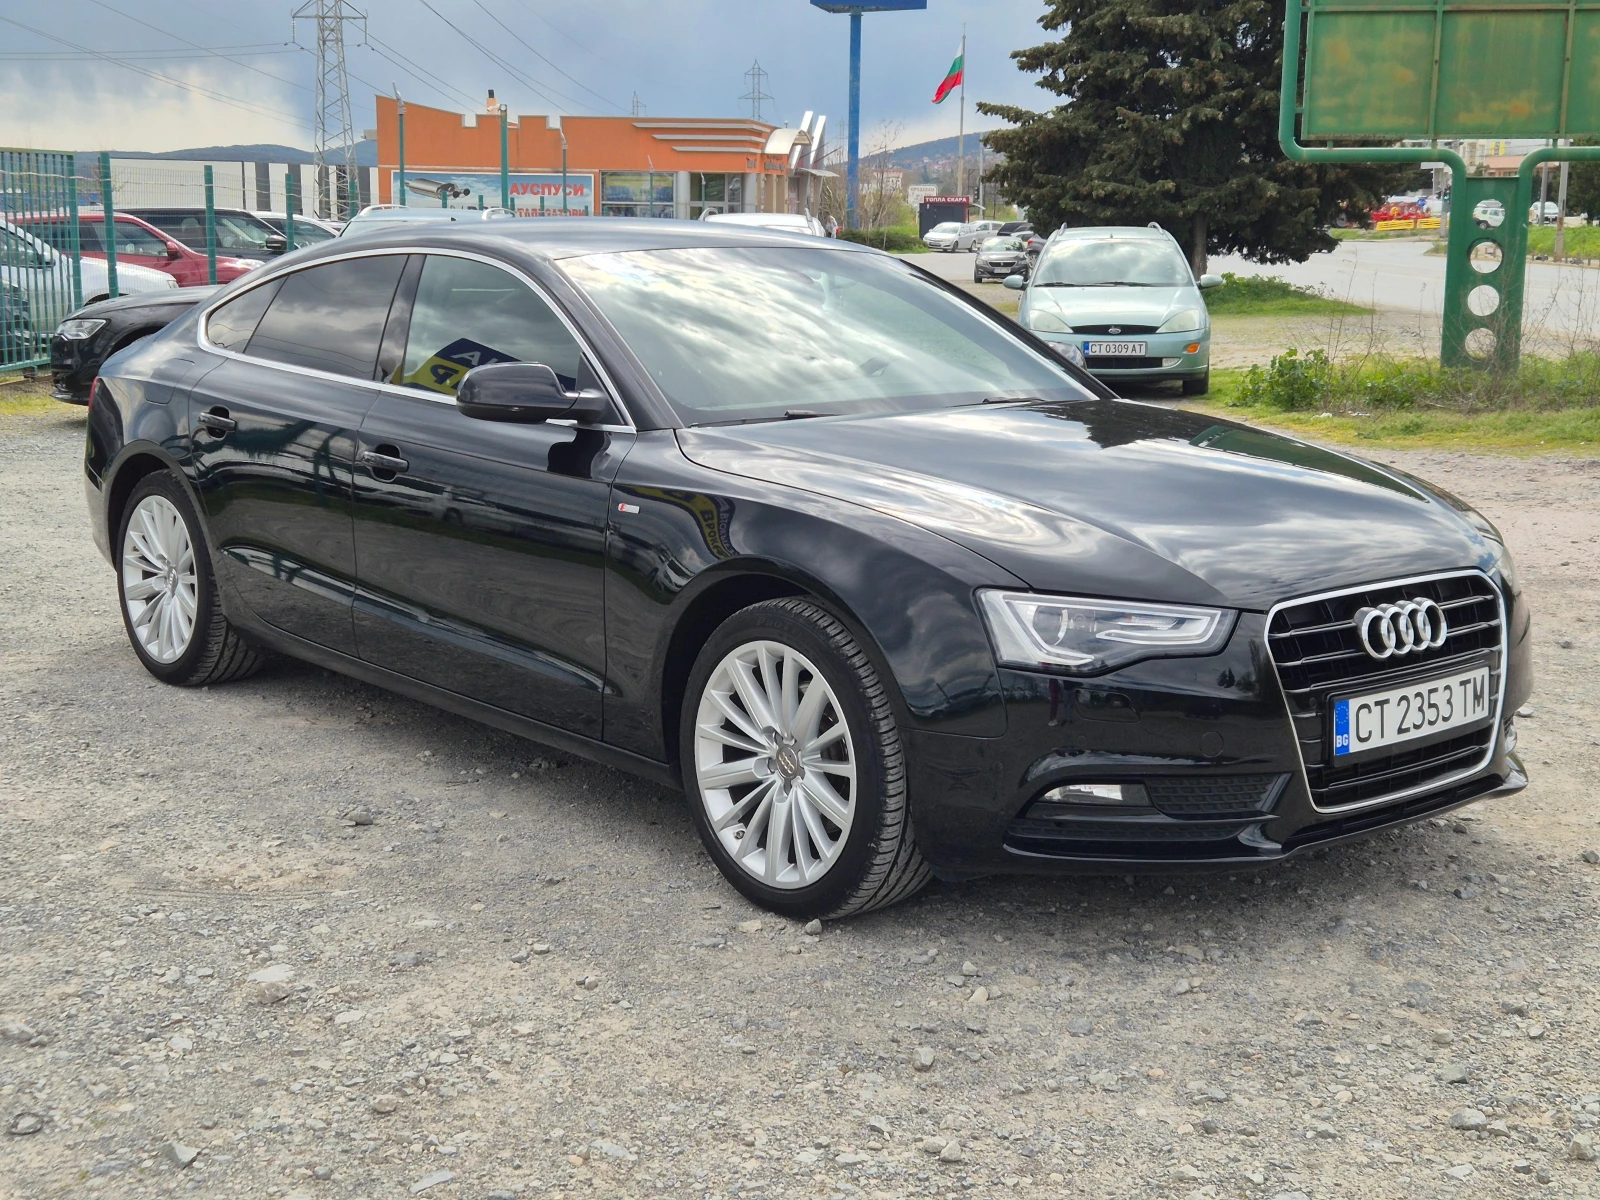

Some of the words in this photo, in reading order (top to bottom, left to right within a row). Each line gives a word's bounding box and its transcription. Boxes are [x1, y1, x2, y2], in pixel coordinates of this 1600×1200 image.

[509, 182, 585, 196] АУСПУСИ
[1090, 343, 1104, 354] CT
[1105, 343, 1129, 354] 0309
[1130, 343, 1144, 354] AT
[1355, 697, 1391, 743] CT
[1396, 684, 1454, 736] 2353
[1459, 674, 1485, 718] TM
[1336, 733, 1349, 747] BG
